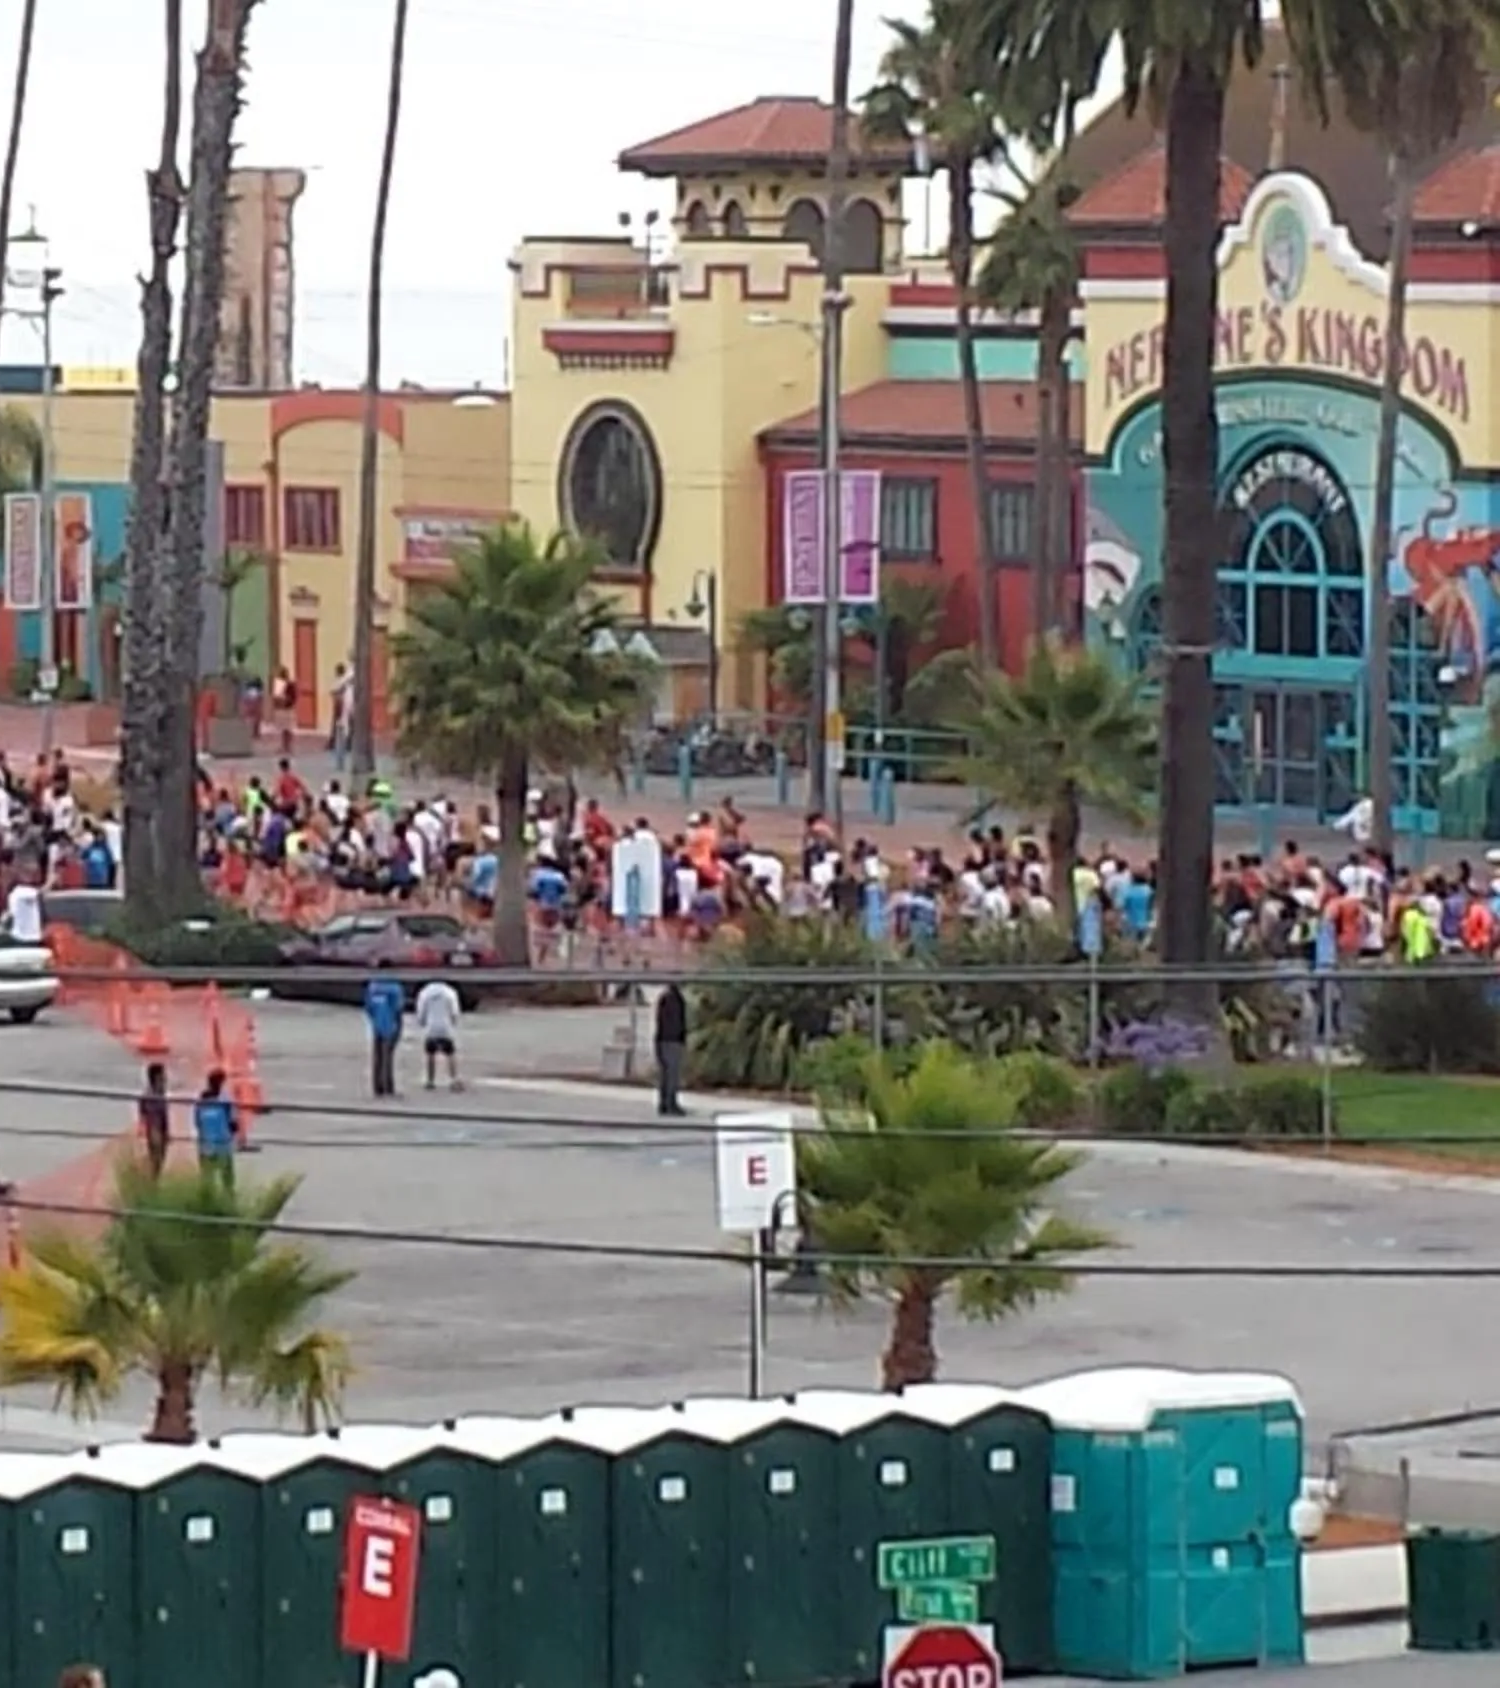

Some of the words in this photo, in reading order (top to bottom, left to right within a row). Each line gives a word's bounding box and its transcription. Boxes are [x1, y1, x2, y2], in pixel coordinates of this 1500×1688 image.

[1104, 301, 1288, 411] NEPNE'S
[747, 1156, 768, 1185] E
[363, 1535, 395, 1598] E
[893, 1661, 993, 1688] STOP
